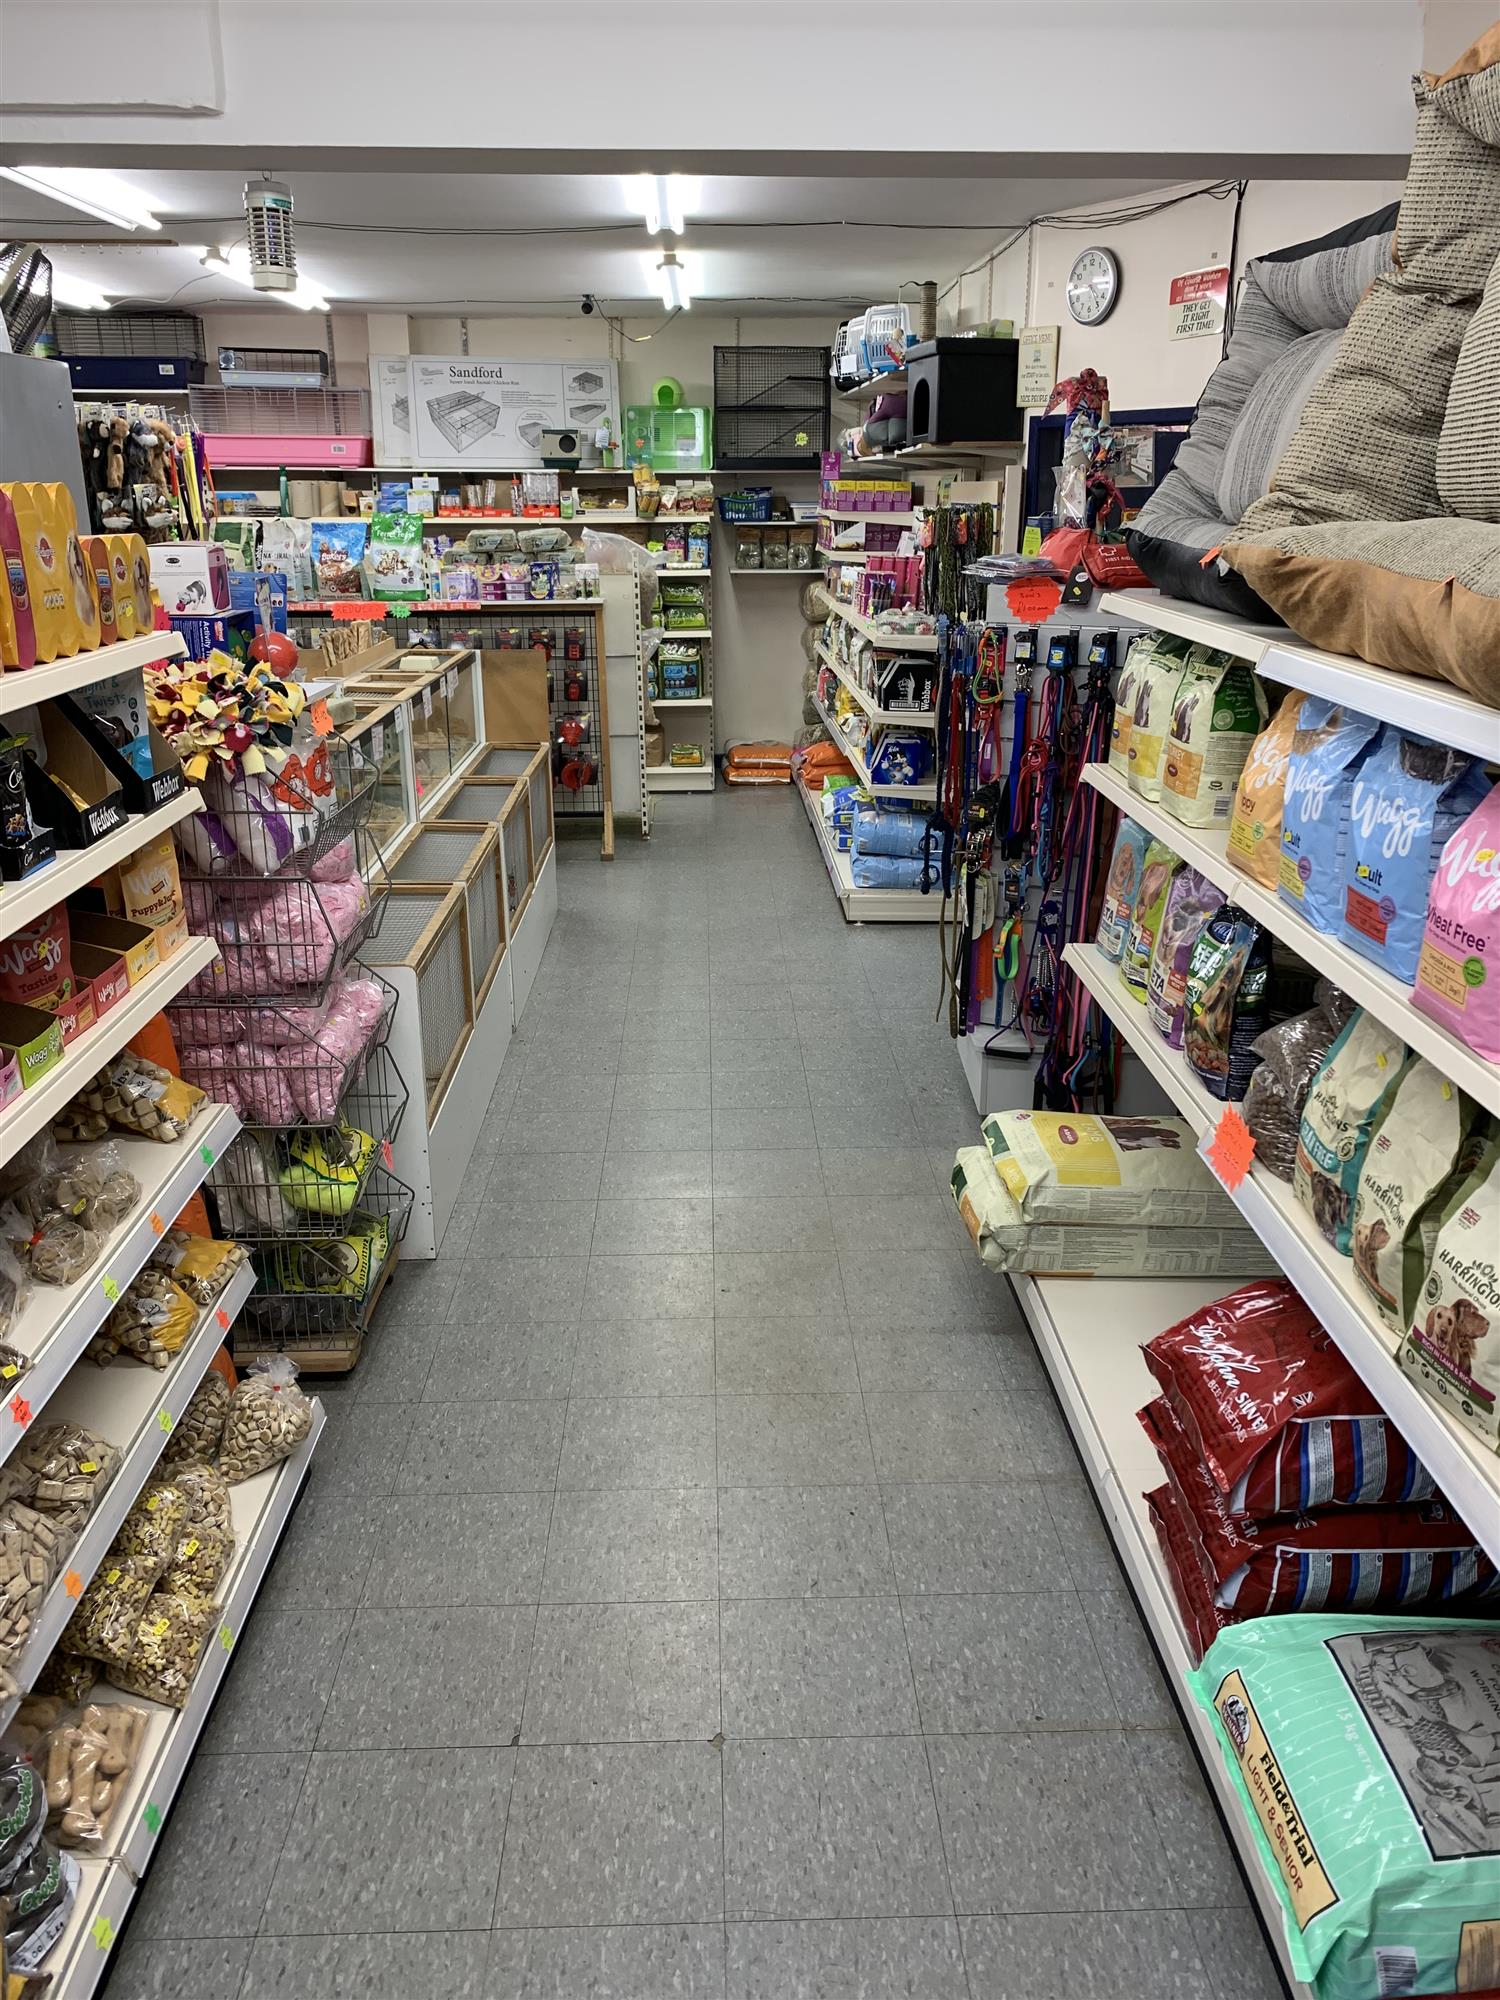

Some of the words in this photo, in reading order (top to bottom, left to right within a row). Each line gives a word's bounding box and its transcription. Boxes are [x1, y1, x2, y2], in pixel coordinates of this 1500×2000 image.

[1182, 302, 1199, 314] THEY
[1200, 300, 1212, 310] GET
[1182, 313, 1189, 324] IT
[1190, 311, 1210, 322] RIGHT
[1176, 323, 1195, 334] FIRST
[1195, 320, 1215, 331] TIME!
[449, 365, 503, 379] Sandford
[203, 620, 211, 649] Activity
[920, 679, 932, 712] Webbox
[152, 774, 180, 802] Webbox
[88, 805, 120, 837] Webbox
[1350, 780, 1432, 859] Wagg
[18, 972, 58, 995] Tasties
[25, 1046, 48, 1068] Wagg
[1182, 1343, 1262, 1389] John
[1421, 1337, 1435, 1352] RICH
[1439, 1354, 1456, 1373] LAMB
[1458, 1370, 1473, 1387] RICE
[1442, 1369, 1470, 1396] COMPLETE
[1247, 1753, 1270, 1805] LIGHT
[1267, 1806, 1277, 1825] &
[1274, 1823, 1304, 1893] SENIOR
